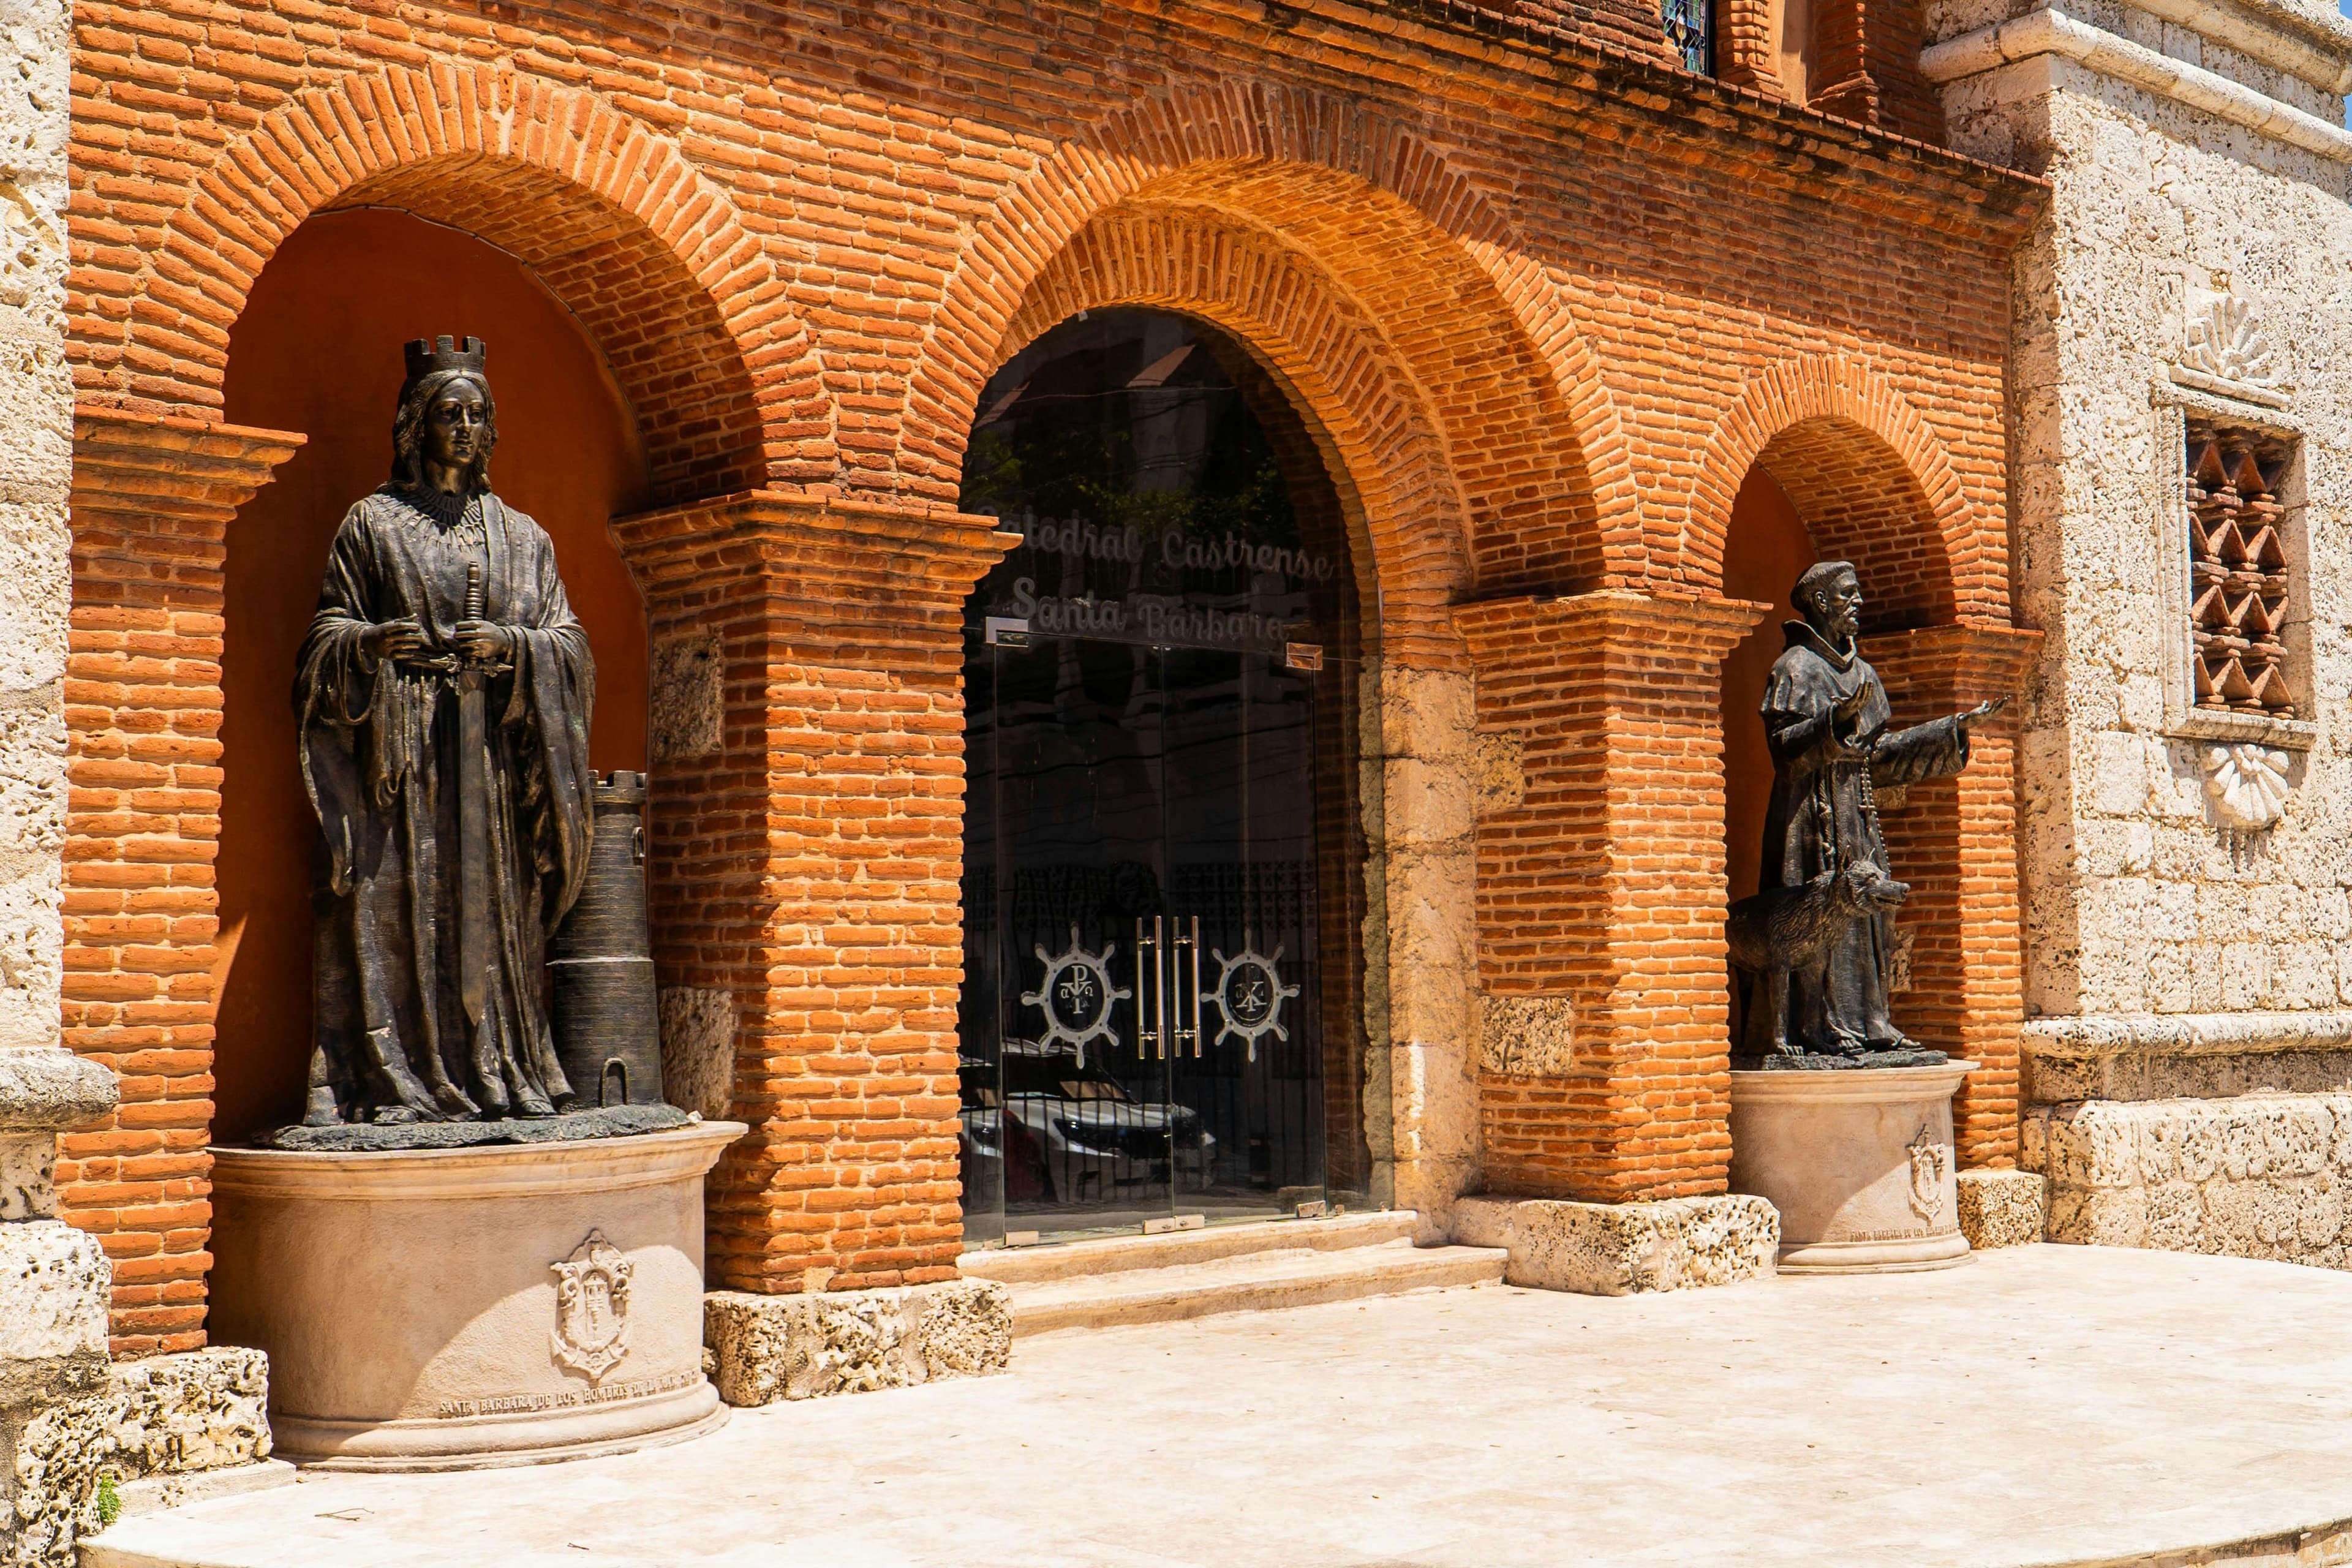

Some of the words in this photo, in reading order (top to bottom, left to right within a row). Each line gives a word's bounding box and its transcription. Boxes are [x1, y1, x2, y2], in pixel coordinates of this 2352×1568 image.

[978, 503, 1145, 562] tedral
[1163, 527, 1333, 579] Castrense
[1012, 577, 1126, 631] Santa
[440, 1400, 473, 1414] SANTA
[480, 1395, 533, 1413] BARBARA
[557, 1392, 575, 1407] LOS
